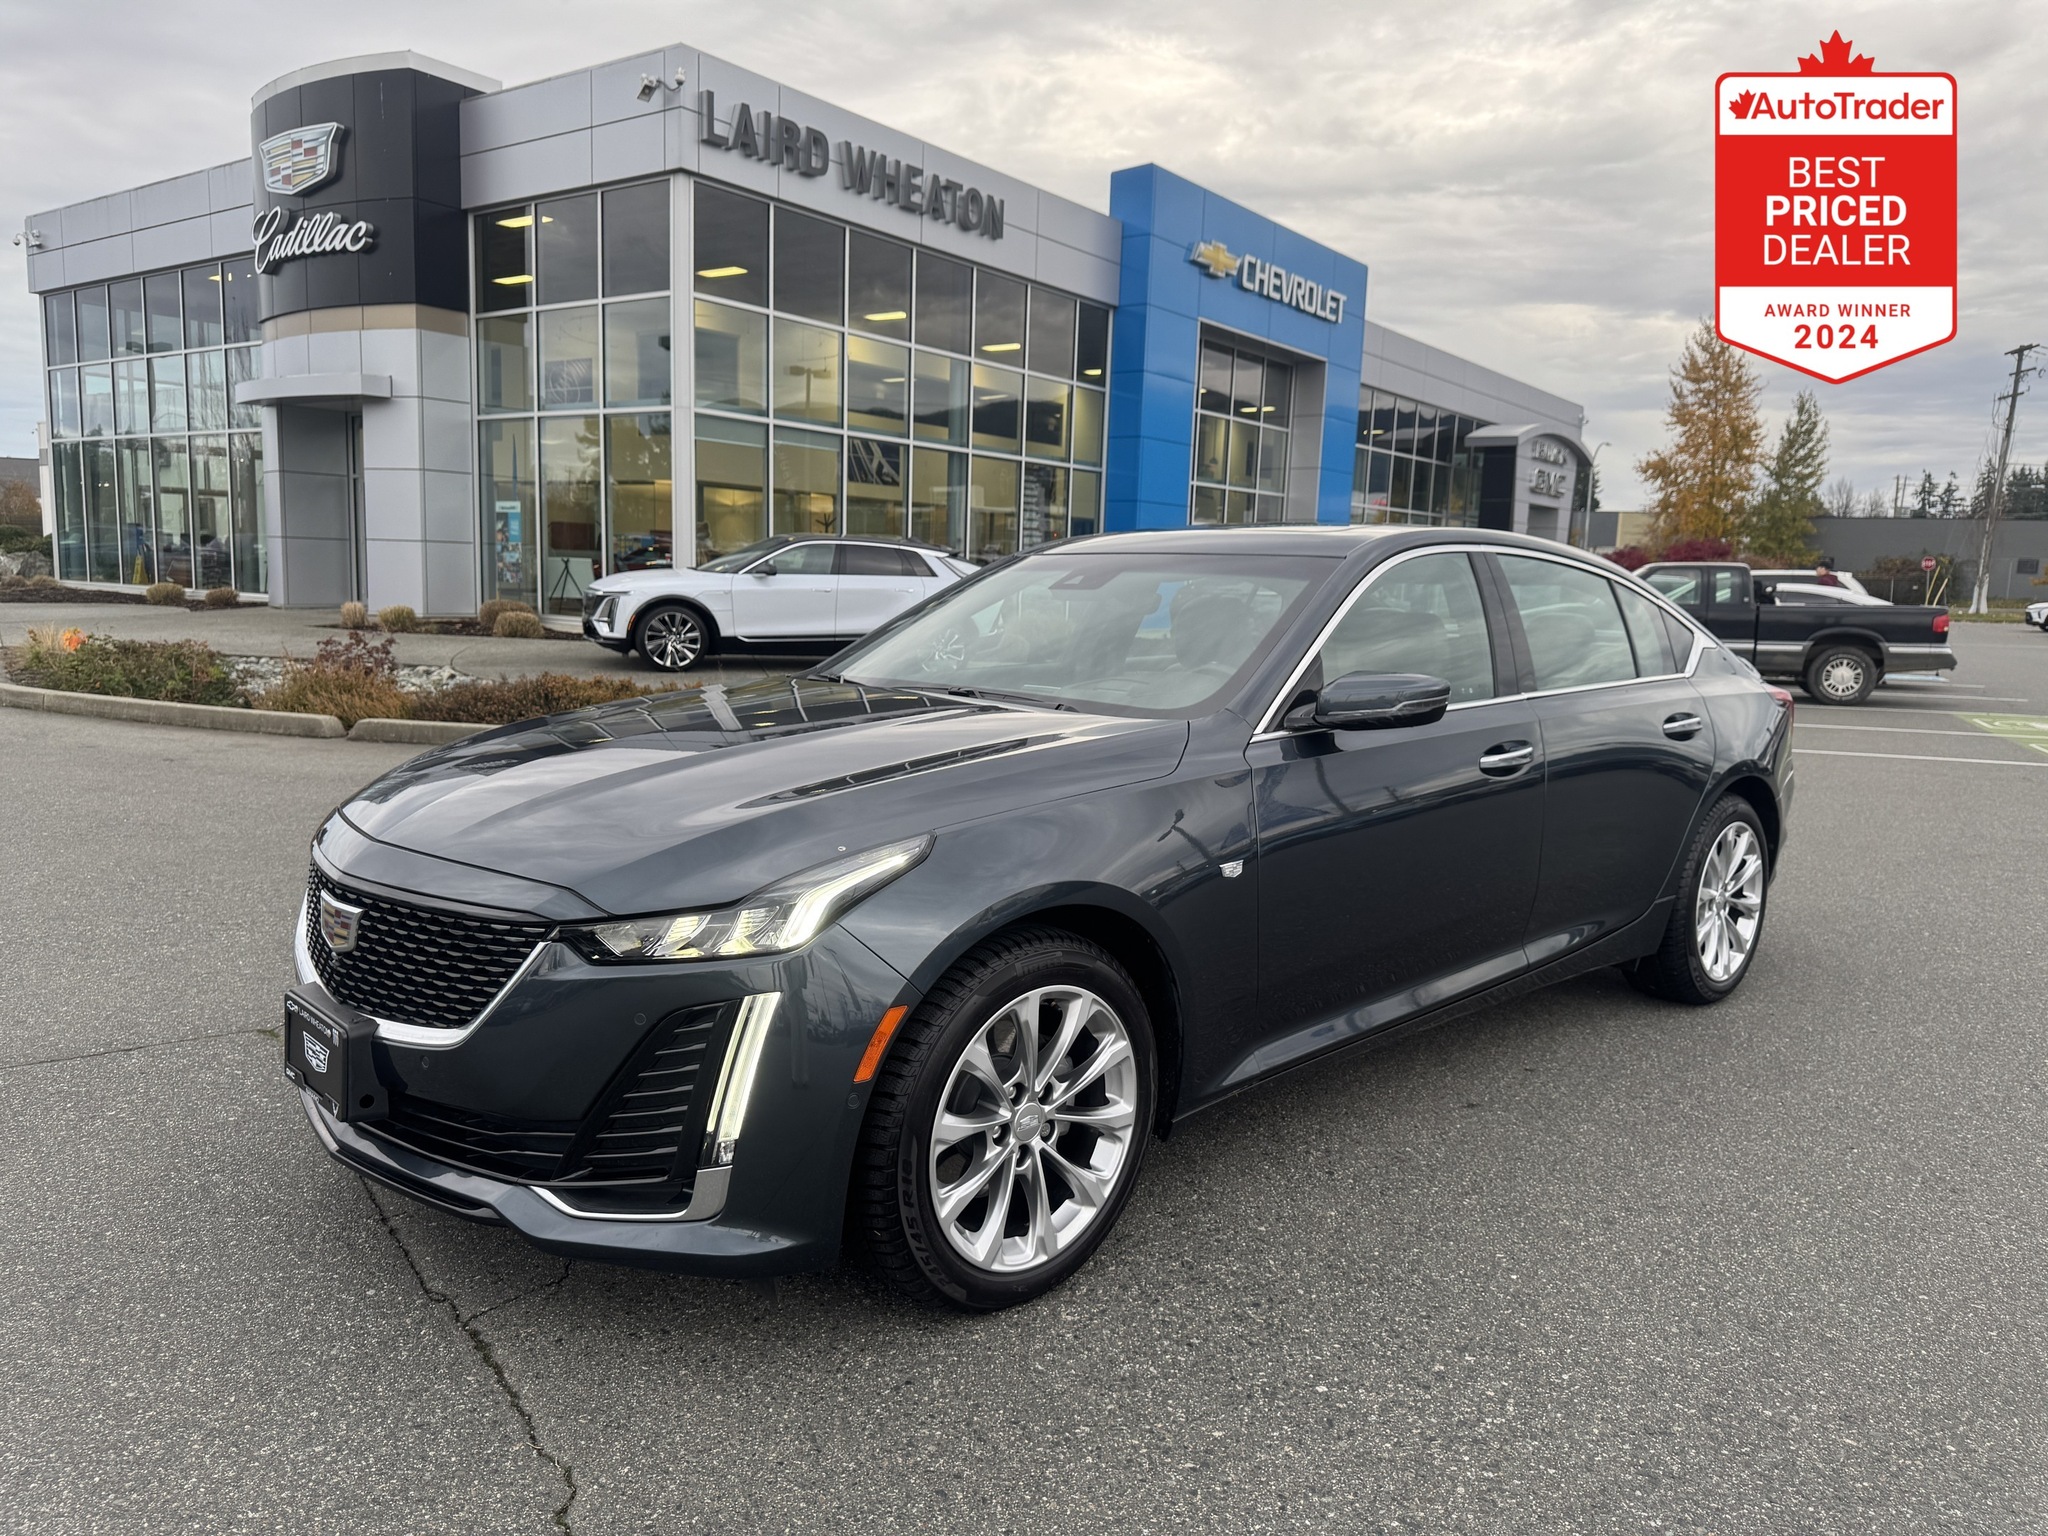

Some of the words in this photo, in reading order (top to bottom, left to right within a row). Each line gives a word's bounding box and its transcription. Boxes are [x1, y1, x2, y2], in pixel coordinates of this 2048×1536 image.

[700, 89, 830, 178] LAIRD
[835, 140, 1005, 240] WHEATON
[251, 205, 368, 275] Cadillac
[1241, 253, 1348, 324] CHEVROLET
